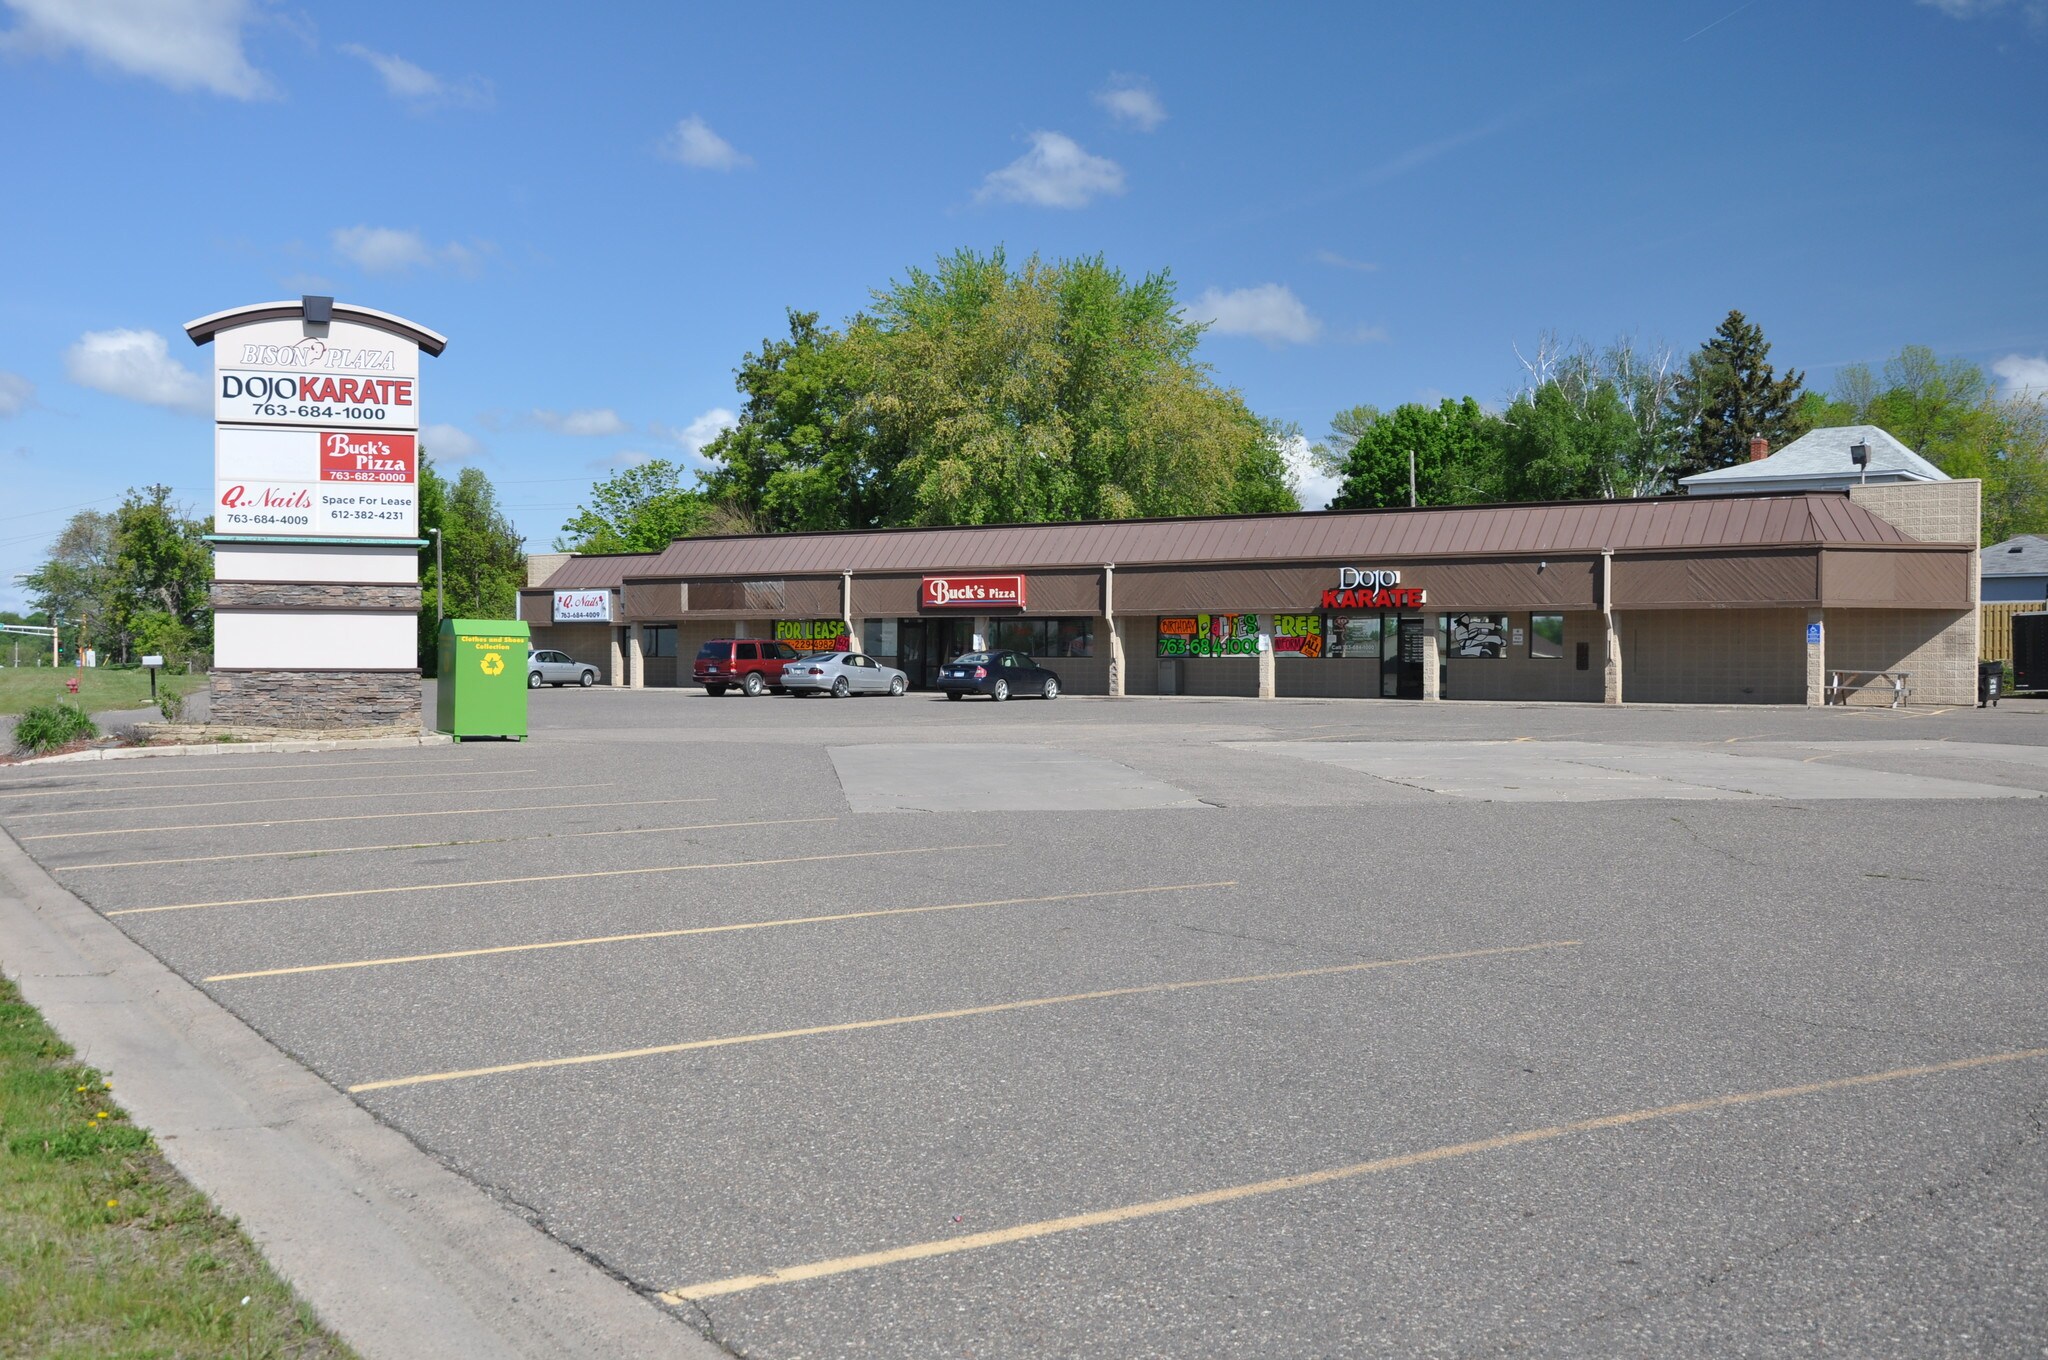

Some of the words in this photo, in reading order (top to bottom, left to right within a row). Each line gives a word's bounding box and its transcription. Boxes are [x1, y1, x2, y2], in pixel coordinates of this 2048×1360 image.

[240, 344, 310, 367] BISON
[325, 348, 395, 370] PLAZA
[222, 375, 297, 404] DOJO
[299, 376, 413, 406] KARATE
[252, 403, 386, 420] 763-684-1000
[326, 433, 391, 457] Buck's
[355, 455, 406, 471] Pizza
[329, 471, 406, 482] 763-682-0000
[247, 487, 312, 509] Nails
[322, 495, 355, 506] Space
[359, 496, 378, 505] For
[381, 497, 412, 506] Lease
[227, 514, 309, 525] 763-684-4009
[331, 510, 404, 520] 612-382-4231
[930, 579, 985, 605] Buck's
[989, 588, 1016, 599] Pizza
[1322, 588, 1424, 608] KARATE
[575, 595, 599, 607] Nails
[777, 621, 802, 639] FOR
[805, 621, 845, 639] LEASE
